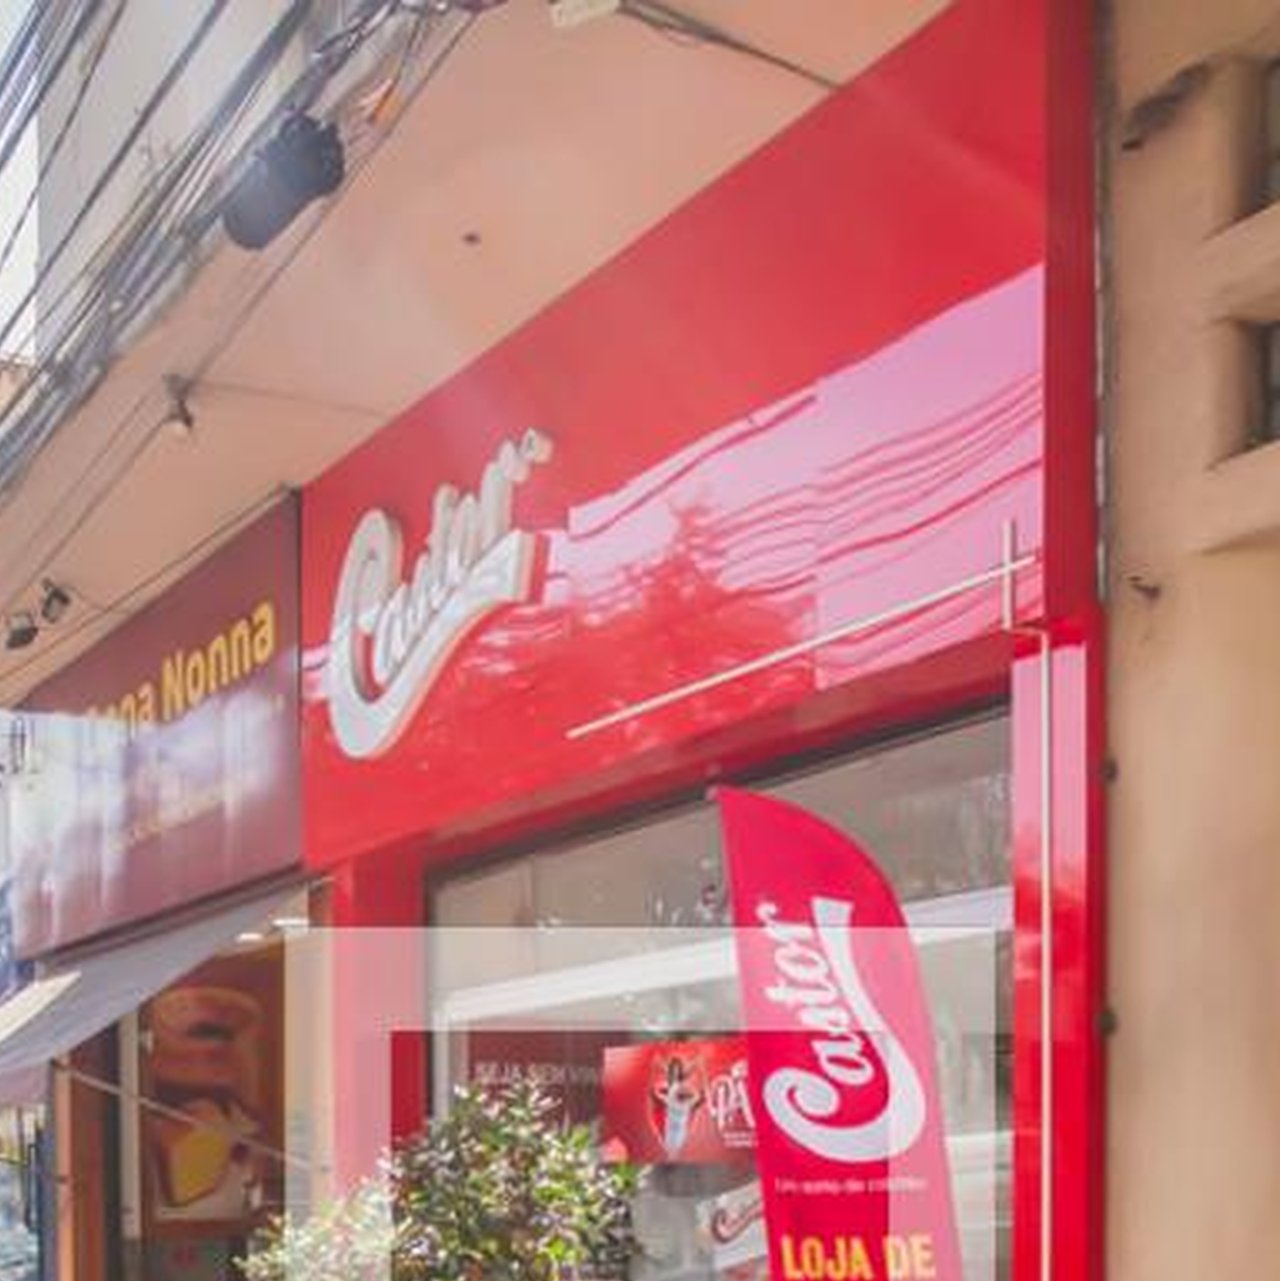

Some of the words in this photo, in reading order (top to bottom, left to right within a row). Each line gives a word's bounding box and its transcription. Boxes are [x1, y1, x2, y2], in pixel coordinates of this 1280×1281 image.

[161, 600, 274, 723] Nonna
[756, 896, 926, 1163] Castor
[780, 1235, 874, 1281] LOJA
[882, 1232, 937, 1279] DE
